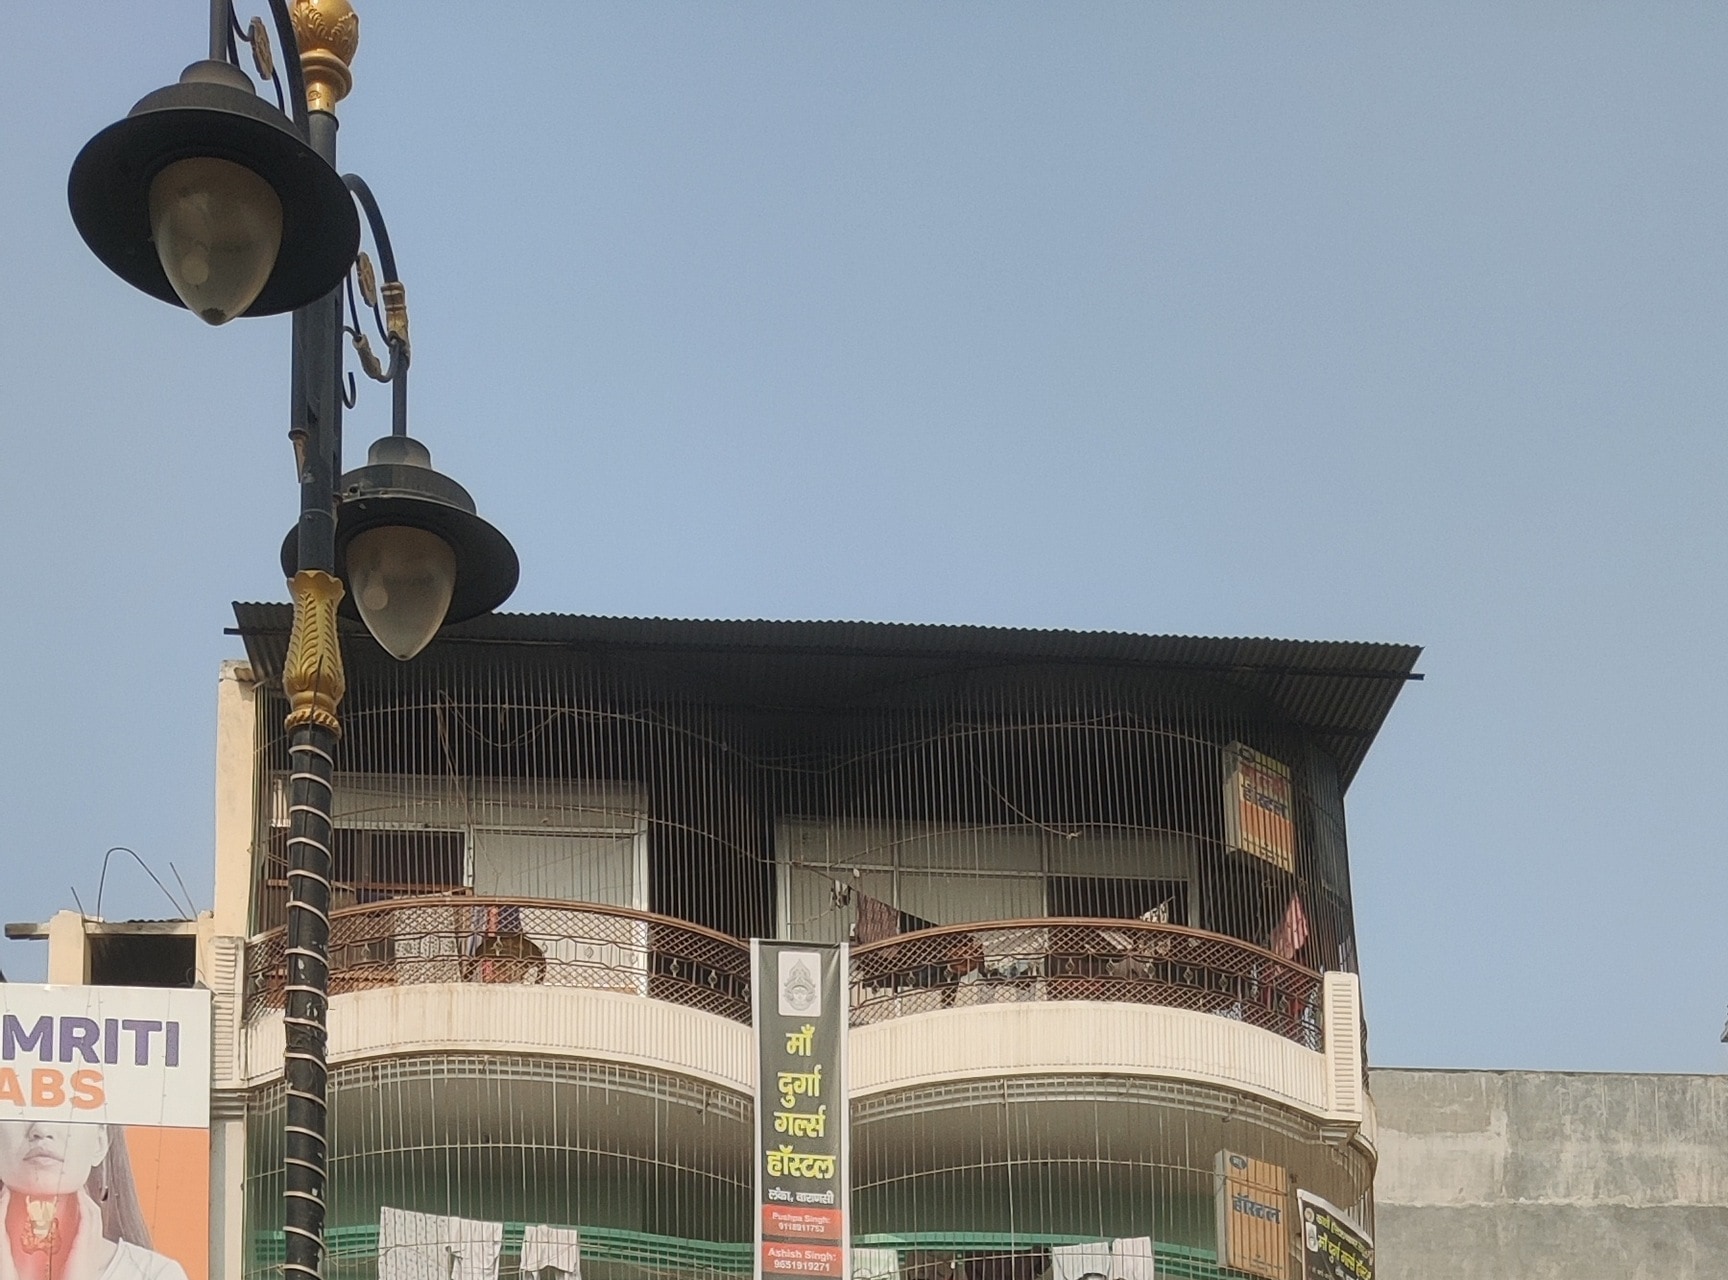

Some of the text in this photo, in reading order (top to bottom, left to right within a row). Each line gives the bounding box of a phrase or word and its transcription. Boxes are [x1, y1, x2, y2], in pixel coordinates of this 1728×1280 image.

[2, 1014, 180, 1067] MRITI
[786, 1023, 816, 1056] माँ
[778, 1064, 822, 1109] दुर्गा
[773, 1105, 826, 1138] गर्ल्स
[766, 1144, 837, 1179] हॉस्टल
[768, 1248, 802, 1259] Ashish
[774, 1259, 830, 1272] 9651919271
